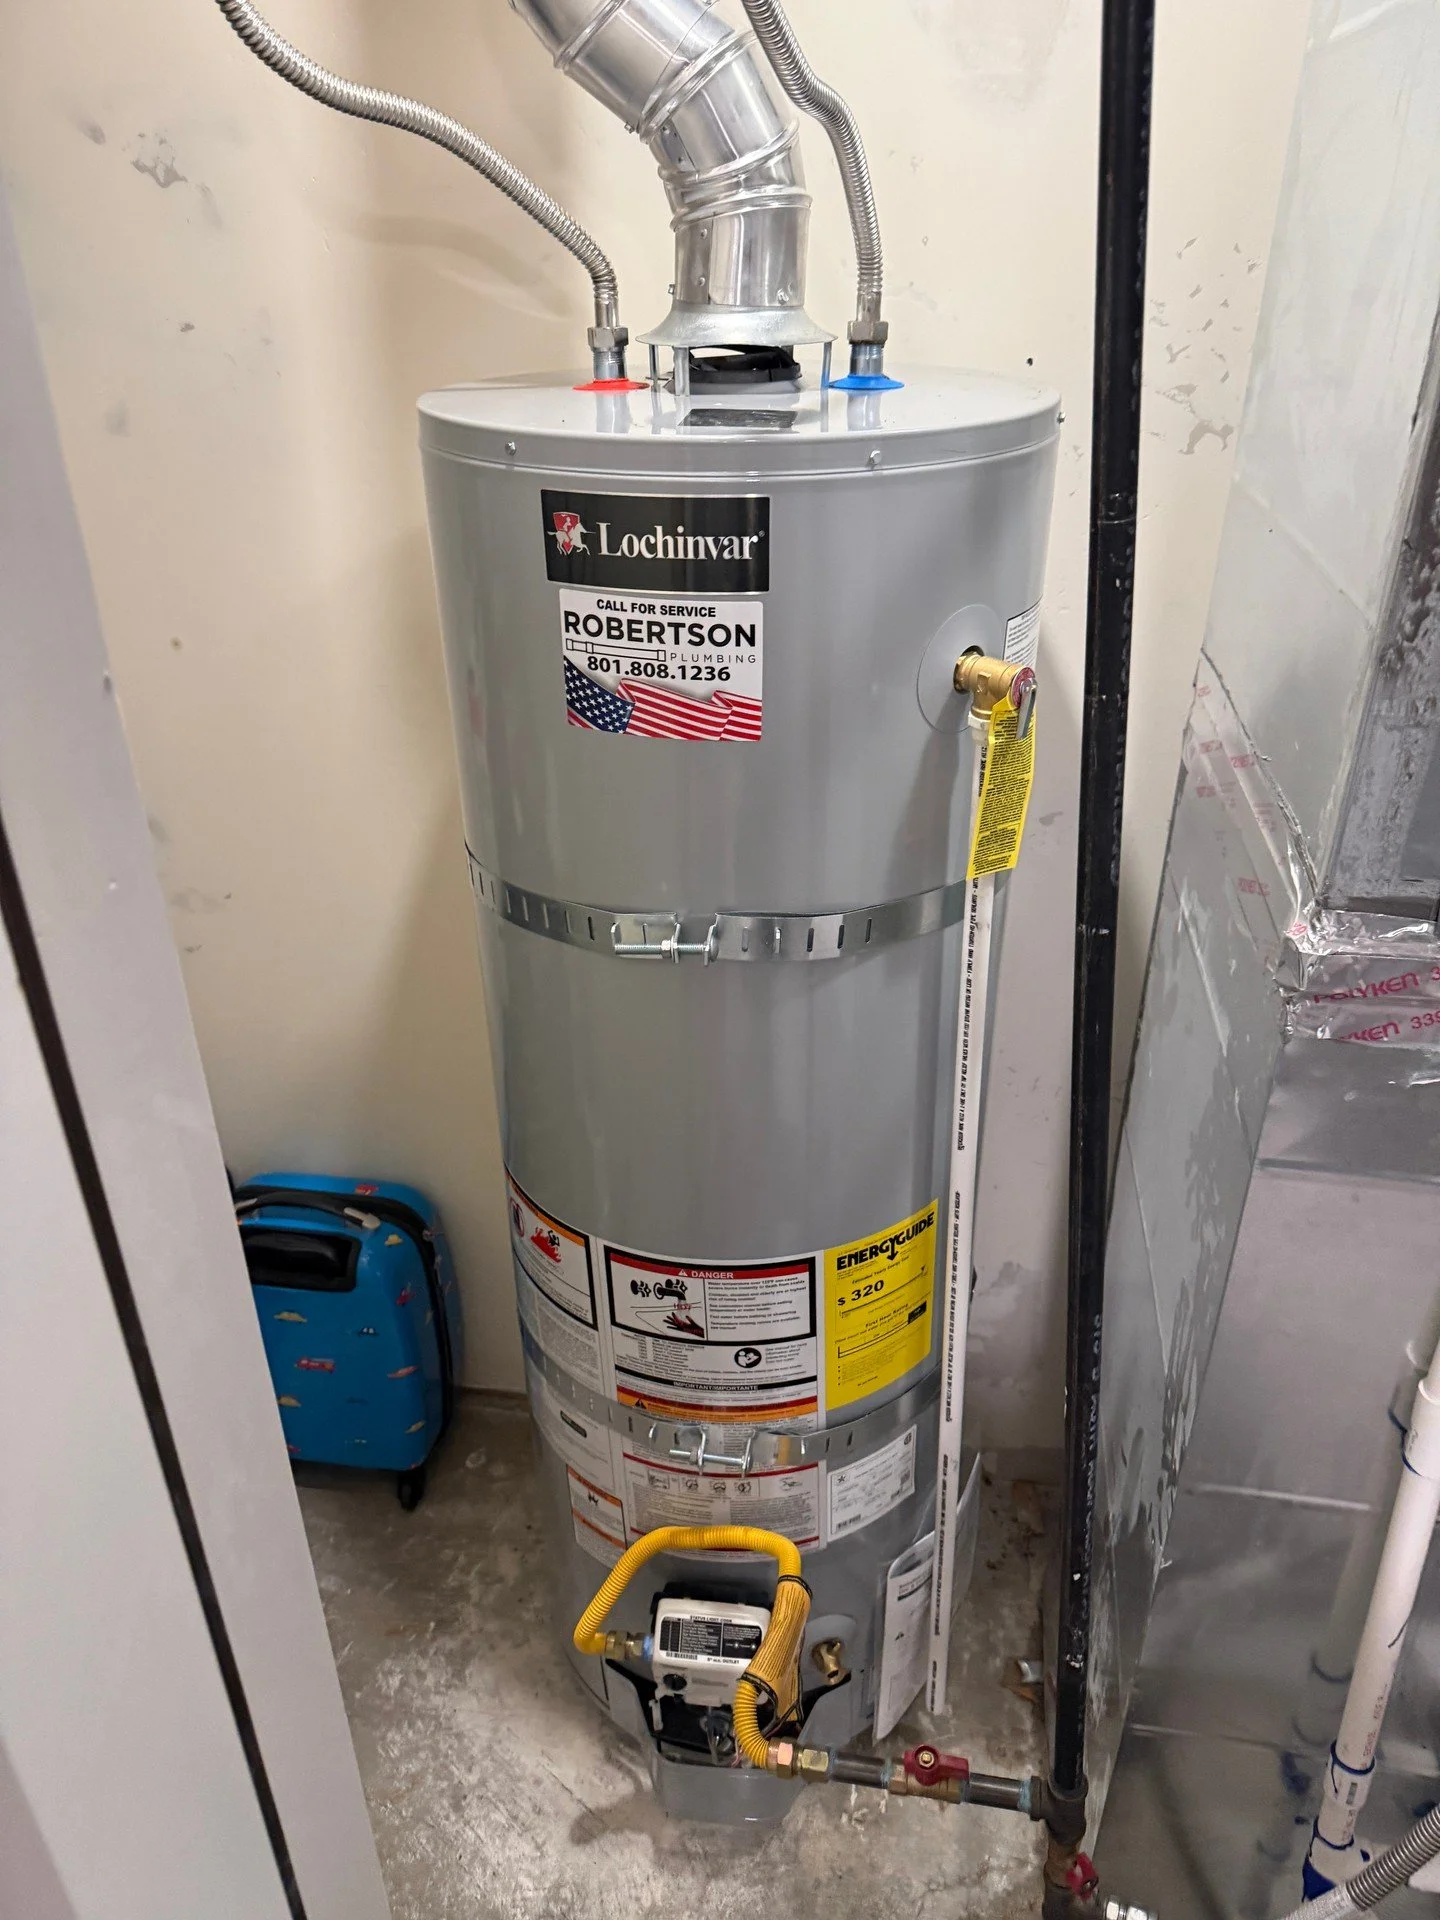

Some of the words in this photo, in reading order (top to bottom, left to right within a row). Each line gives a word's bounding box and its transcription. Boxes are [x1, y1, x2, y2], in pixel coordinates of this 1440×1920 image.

[596, 522, 758, 561] Lochinvar
[596, 598, 627, 613] CALL
[631, 602, 656, 615] FOR
[660, 605, 716, 617] SERVICE
[563, 610, 756, 648] ROBERTSON
[587, 656, 731, 681] 801.808.1236
[670, 653, 756, 663] PLUMBING
[1313, 972, 1420, 1003] POLYKEN
[691, 1271, 734, 1279] DANGER
[851, 1280, 884, 1301] 320
